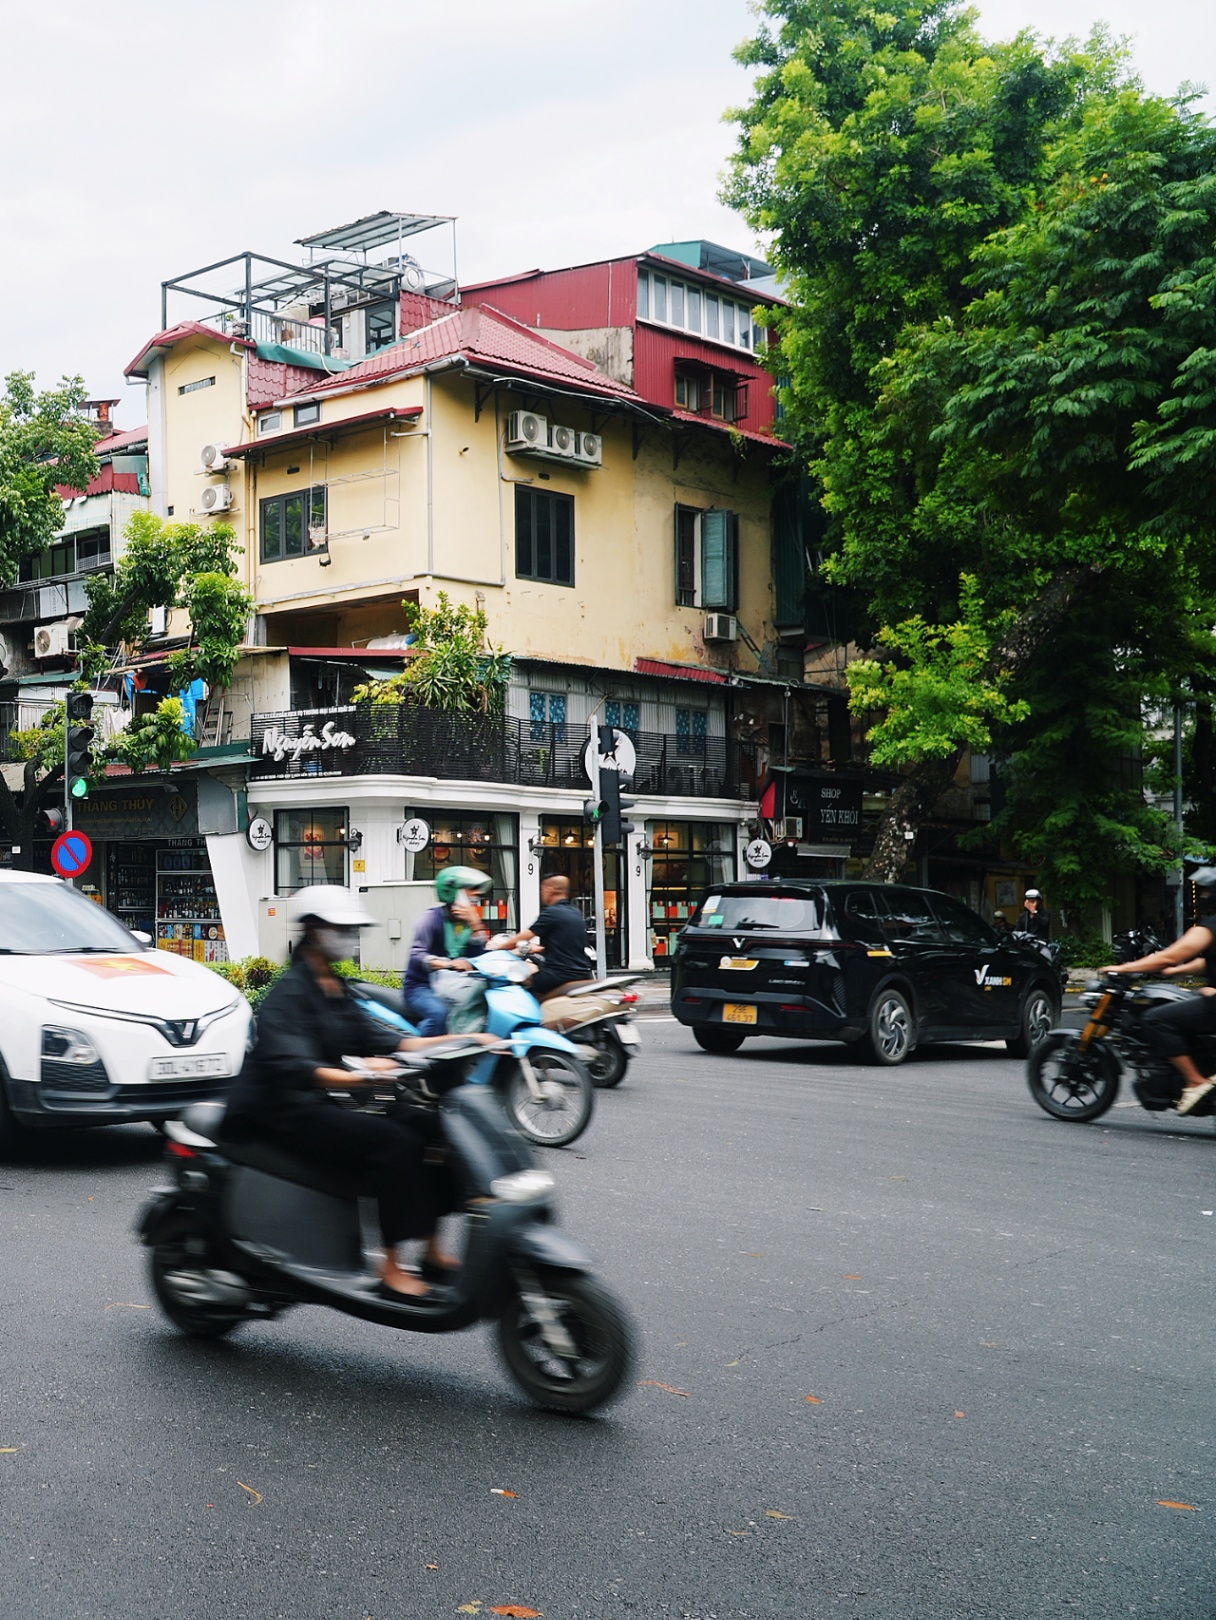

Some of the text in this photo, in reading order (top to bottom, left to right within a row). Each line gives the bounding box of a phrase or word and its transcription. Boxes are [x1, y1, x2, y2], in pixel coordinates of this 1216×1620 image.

[262, 724, 322, 761] Nguyễn
[820, 787, 842, 799] SHOP
[527, 863, 534, 875] 9
[635, 865, 641, 877] 9
